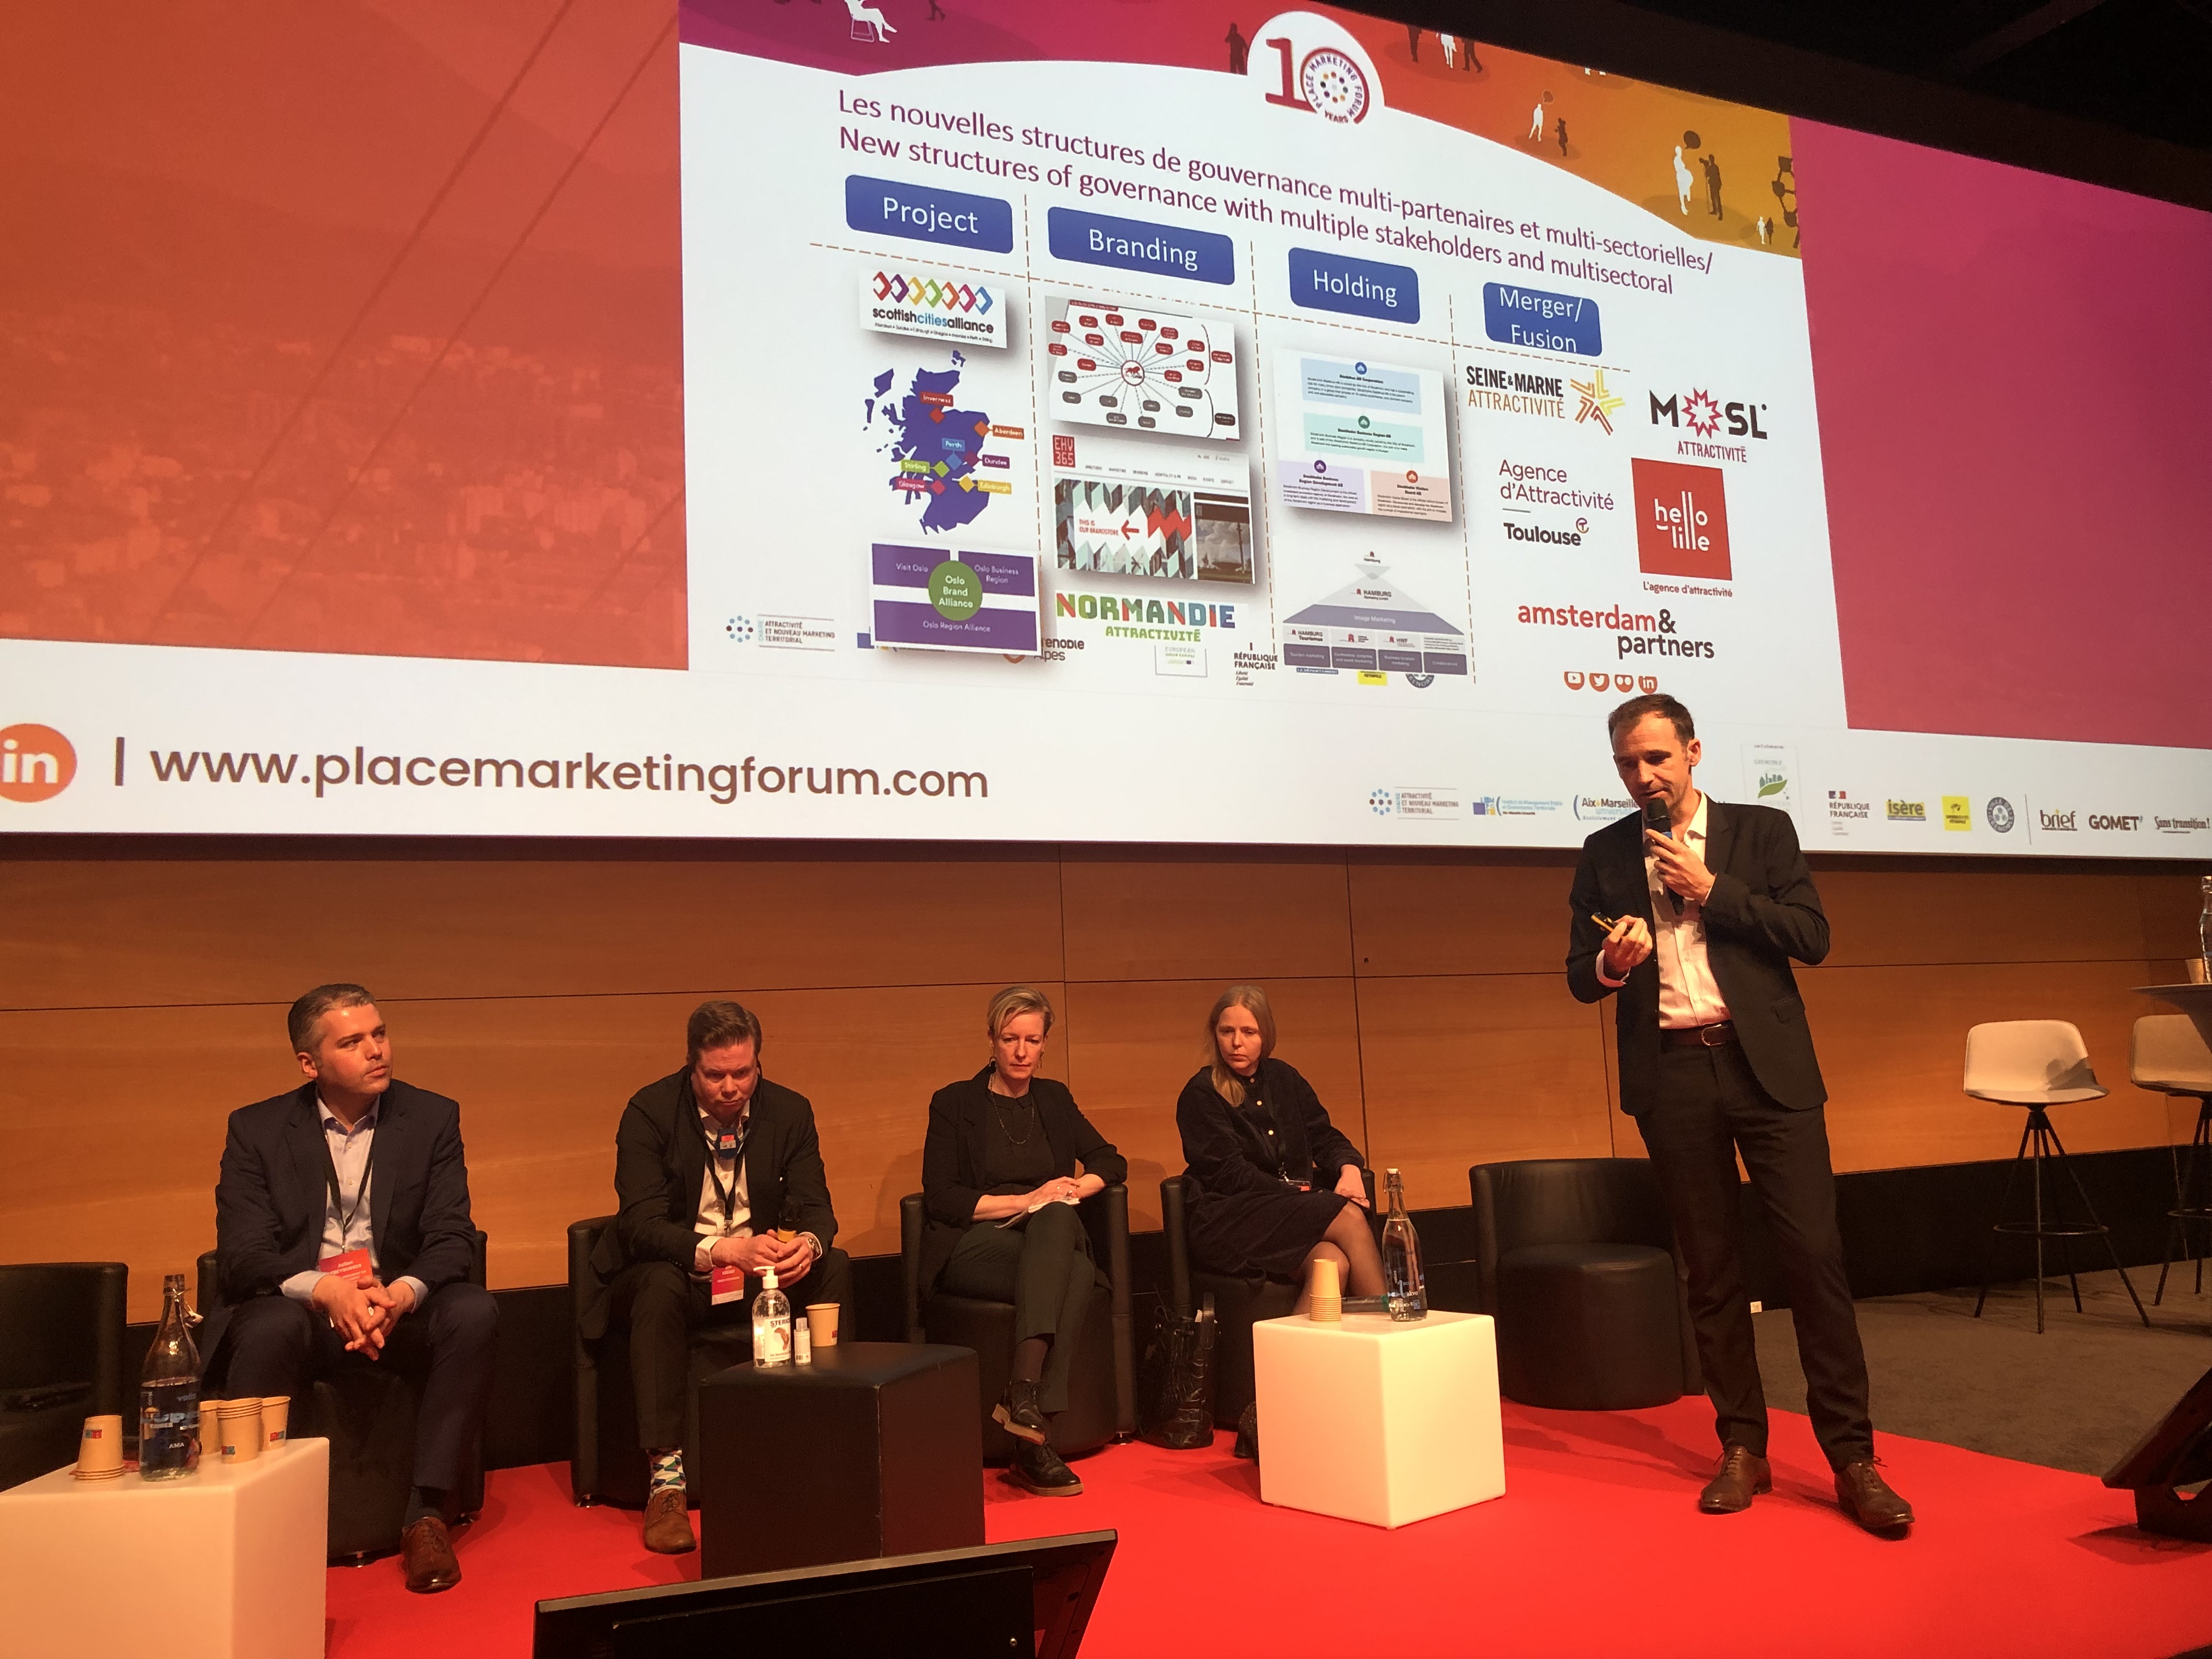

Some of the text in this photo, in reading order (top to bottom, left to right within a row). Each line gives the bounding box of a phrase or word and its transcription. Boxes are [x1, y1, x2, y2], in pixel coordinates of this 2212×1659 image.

[1306, 53, 1363, 117] PLACE MARKETING FORUM
[1324, 110, 1348, 123] YEARS
[839, 90, 1713, 274] Les nouvelles structures de gouvernance multi-partenaires et multi-sectorielles/
[840, 126, 1673, 295] New structures of governance with multiple stakeholders and multisectoral
[883, 196, 979, 234] Project
[1089, 228, 1198, 272] Branding
[1313, 269, 1398, 308] Holding
[1499, 287, 1583, 323] Merger/
[873, 307, 994, 334] scottishcitiesalliance
[1510, 324, 1577, 354] Fusion
[1468, 389, 1566, 419] ATTRACTIVITÉ
[994, 427, 1023, 437] Aberdeen
[945, 440, 962, 449] Perth
[1053, 437, 1074, 452] EHV
[1677, 440, 1747, 463] ATTRACTIVITÉ
[984, 457, 1007, 466] Dundee
[1055, 452, 1074, 466] 365
[1499, 459, 1567, 483] Agence
[898, 481, 925, 490] Glasgow
[1500, 483, 1614, 511] d'Attractivité
[1654, 491, 1708, 528] hello
[1503, 522, 1582, 546] Toulouse
[896, 563, 929, 573] Visit Oslo
[974, 564, 1019, 575] Oslo Business
[945, 575, 966, 585] Oslo
[986, 575, 1008, 585] Region
[1643, 580, 1733, 597] L'agence d'attractivité
[943, 586, 968, 597] Brand
[939, 597, 974, 609] Alliance
[1056, 592, 1235, 629] NORMANDIE
[803, 630, 835, 639] MARKETING
[923, 620, 991, 633] Oslo Region Alliance
[1105, 625, 1201, 642] ATTRACTIVITÉ
[1617, 635, 1715, 660] partners
[1234, 651, 1278, 663] RÉPUBLIQUE
[1234, 661, 1276, 670] FRANÇAISE
[149, 746, 989, 804] www.placemarketingforum.com
[1582, 797, 1596, 808] Aix
[1829, 802, 1870, 811] RÉPUBLIQUE
[1888, 799, 1924, 816] isère
[1830, 810, 1869, 819] FRANÇAISE
[2040, 809, 2076, 828] brief
